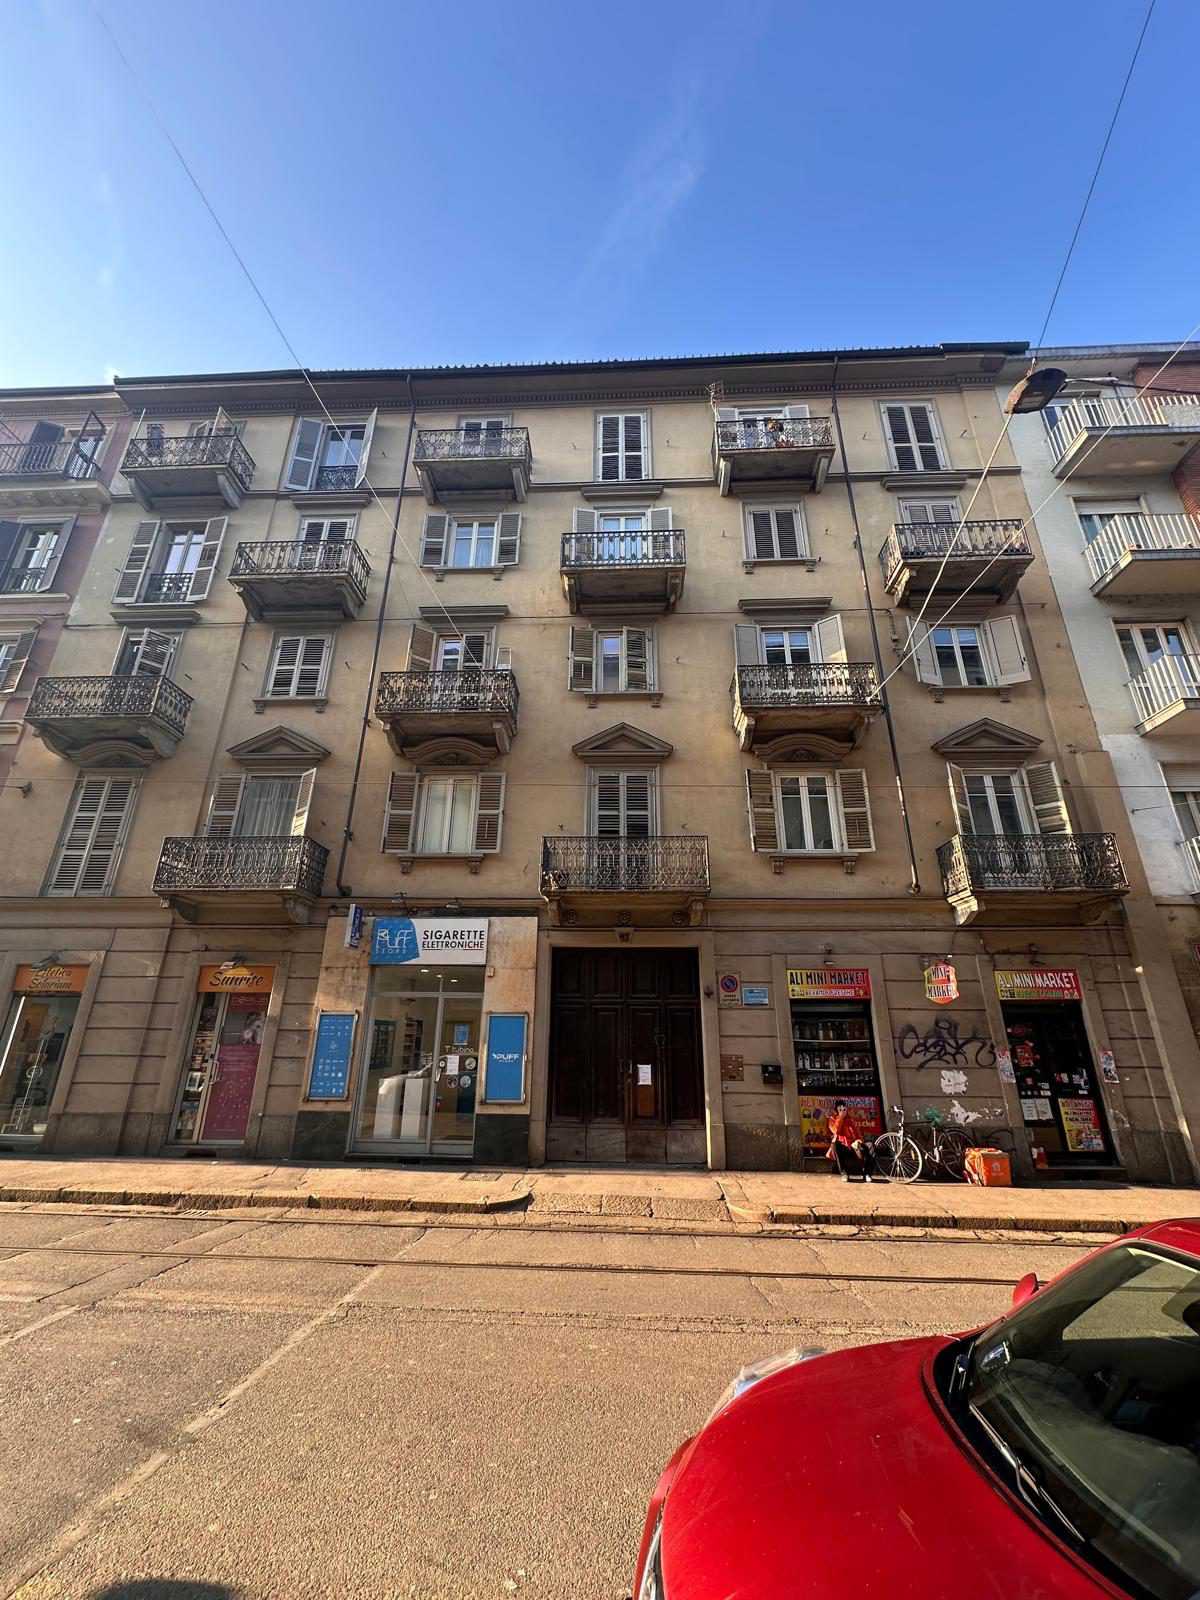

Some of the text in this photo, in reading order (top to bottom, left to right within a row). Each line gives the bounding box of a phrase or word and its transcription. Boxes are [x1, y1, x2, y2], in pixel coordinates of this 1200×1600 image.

[422, 929, 486, 941] SIGARETTE
[421, 940, 486, 949] ELETTRONICHE
[789, 971, 866, 986] ALI MINI MARKET
[1013, 973, 1036, 988] MINI
[1034, 972, 1077, 988] MARKET
